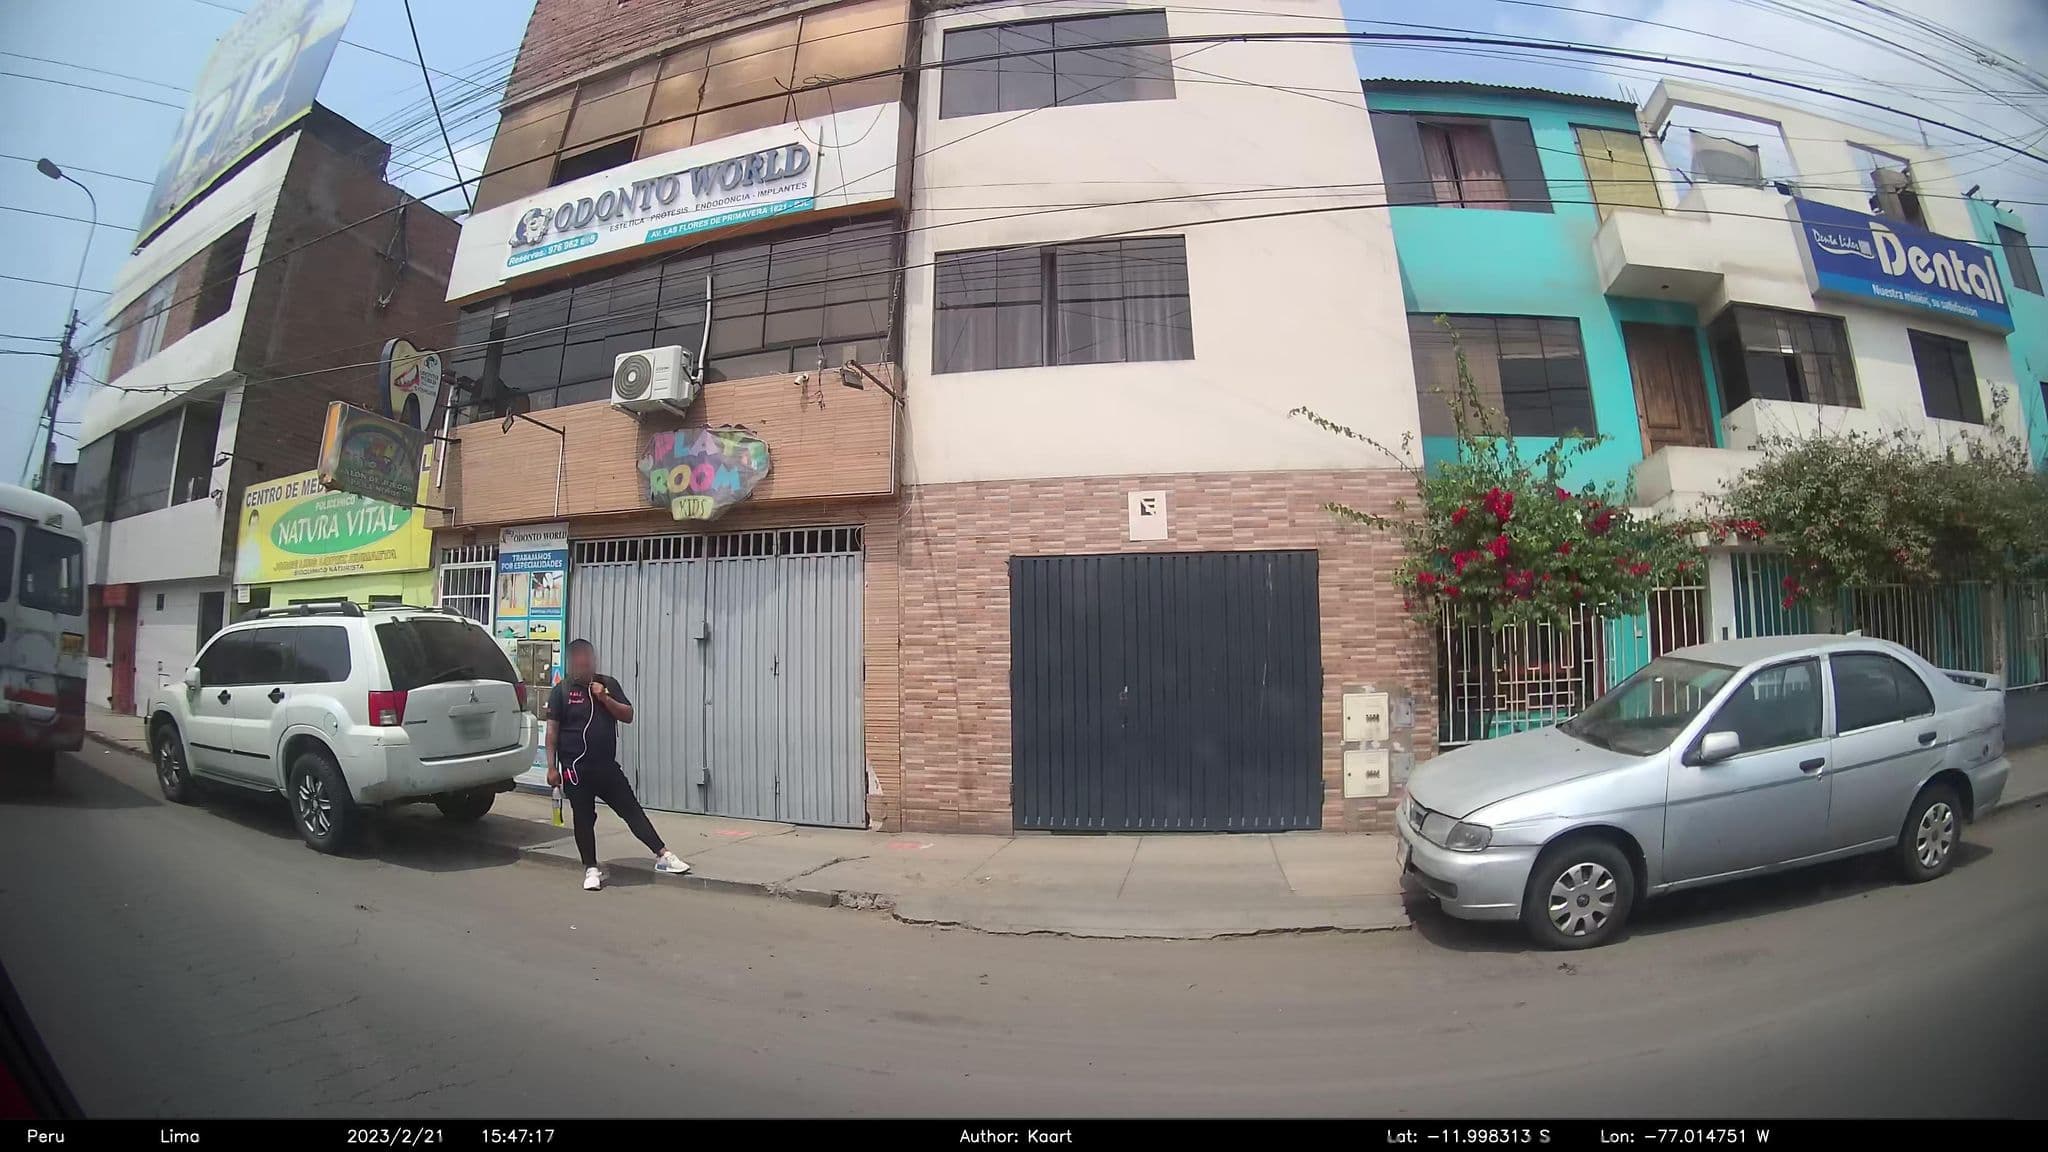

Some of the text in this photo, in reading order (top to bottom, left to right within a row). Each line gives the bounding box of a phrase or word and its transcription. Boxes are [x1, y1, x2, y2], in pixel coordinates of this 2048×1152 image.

[552, 143, 812, 232] ODONTO WORLD
[757, 182, 809, 199] IMPLANTES
[721, 208, 769, 224] PRIMAVERA
[1869, 221, 2004, 305] Dental
[1872, 283, 1904, 301] Nuestra
[654, 428, 741, 461] PLAY
[648, 464, 742, 495] ROOM
[246, 486, 282, 507] CENTRO
[285, 481, 299, 499] DE
[679, 496, 706, 518] KIDS
[278, 504, 399, 545] NATURA VITAL
[513, 531, 543, 544] ODONTO
[511, 552, 552, 562] TRABAJAMOS
